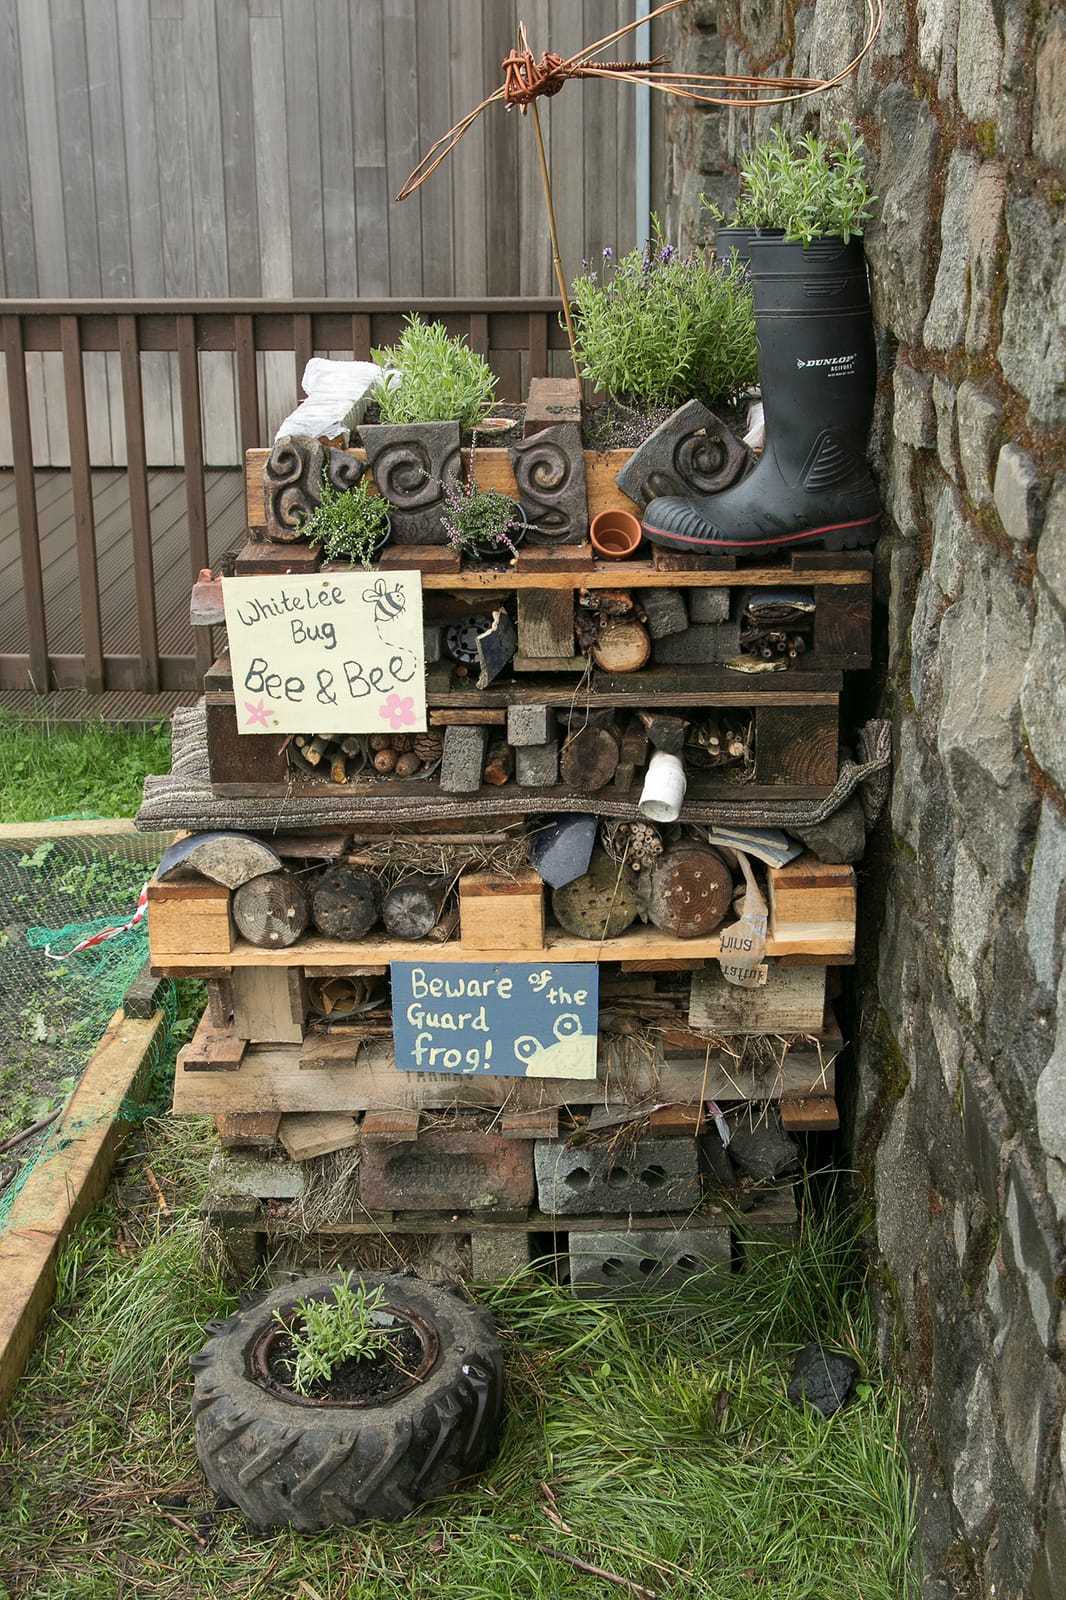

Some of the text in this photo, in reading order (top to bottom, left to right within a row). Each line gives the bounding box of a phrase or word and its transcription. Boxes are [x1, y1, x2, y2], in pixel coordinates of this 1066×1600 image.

[806, 355, 855, 367] DUNLOP
[290, 619, 337, 650] Bug
[244, 656, 415, 705] Bee & Bee
[411, 967, 588, 1005] Beware of the
[406, 1003, 490, 1032] Guard
[410, 1031, 493, 1074] frog!
